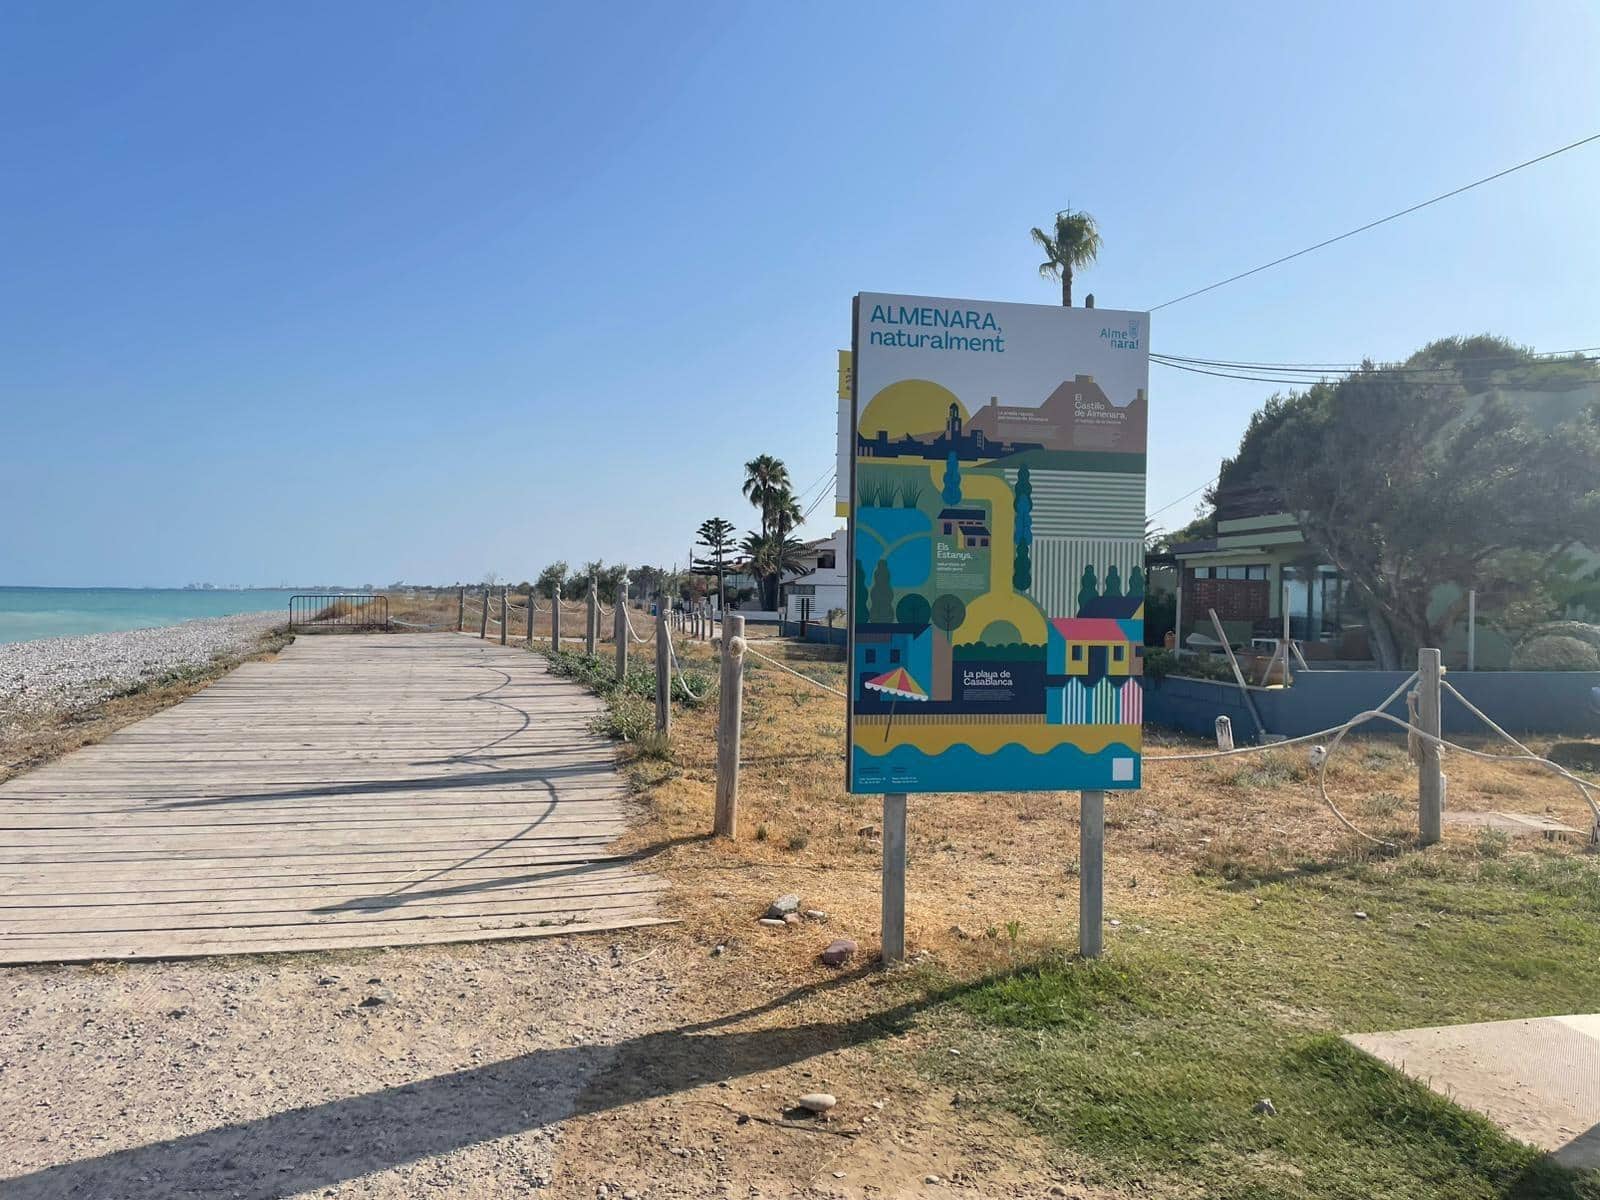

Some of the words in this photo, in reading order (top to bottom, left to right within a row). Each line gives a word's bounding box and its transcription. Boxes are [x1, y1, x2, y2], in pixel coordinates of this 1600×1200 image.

[870, 304, 1002, 334] ALMENARA,
[1100, 328, 1128, 339] Alme
[870, 330, 1005, 352] naturalment
[1075, 393, 1082, 401] El
[1074, 400, 1105, 410] Castillo
[1074, 409, 1085, 417] de
[936, 542, 949, 551] Els
[963, 669, 974, 678] La
[975, 669, 998, 681] playa
[999, 669, 1011, 678] de
[963, 677, 1013, 686] Casablanca
